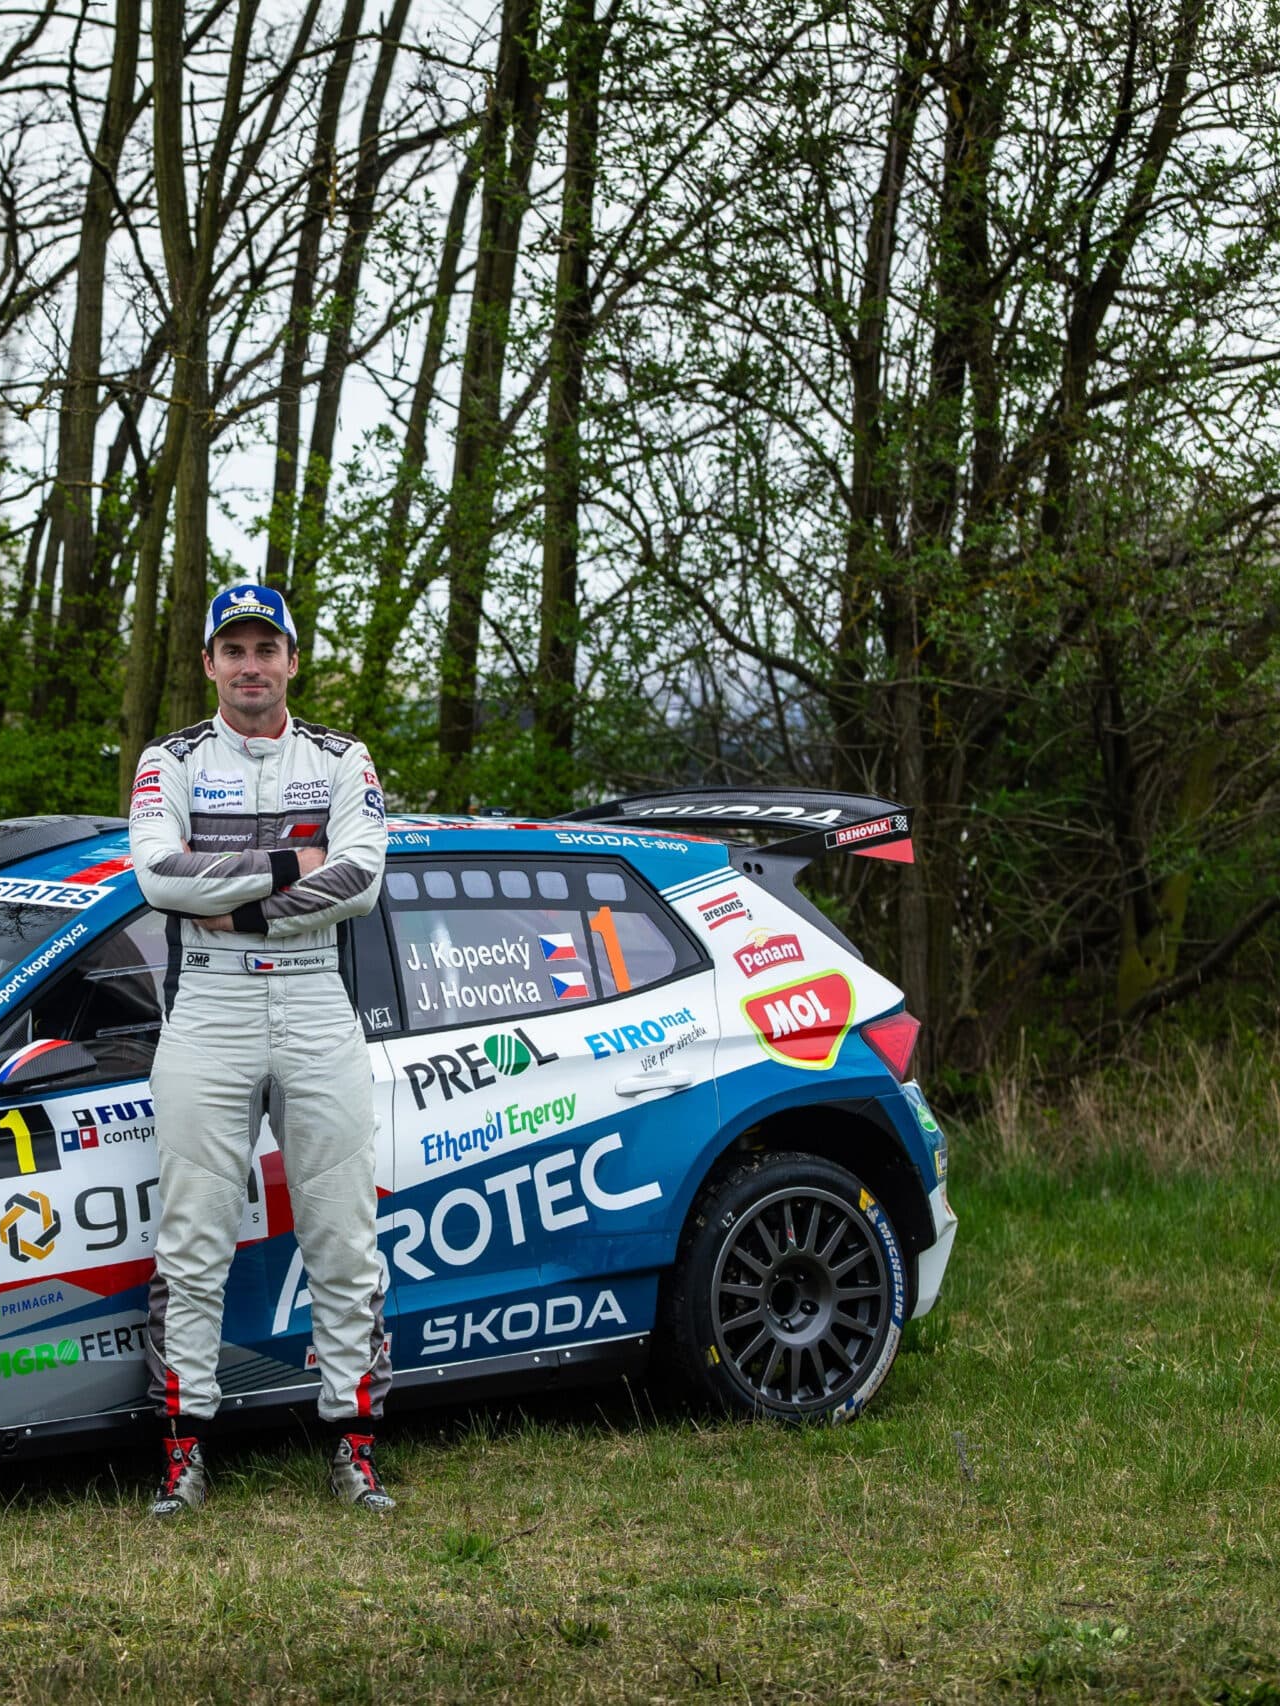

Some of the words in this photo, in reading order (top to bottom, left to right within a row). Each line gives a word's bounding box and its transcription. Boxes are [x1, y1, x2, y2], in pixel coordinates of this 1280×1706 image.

[220, 605, 276, 621] MICHELIN
[194, 787, 227, 799] EVRO
[837, 820, 888, 843] RENOVAK
[638, 837, 689, 854] E-shop
[702, 898, 744, 922] arexons
[186, 955, 210, 964] OMP
[277, 956, 293, 967] Jan
[407, 943, 428, 971] J.
[430, 935, 530, 974] Kopecký
[589, 905, 632, 993] 1
[740, 941, 800, 973] Penam
[418, 982, 439, 1011] J.
[440, 976, 542, 1009] Hovorka
[763, 989, 831, 1039] MOL
[583, 1019, 666, 1061] EVRO
[659, 1007, 697, 1028] mat
[660, 1044, 675, 1066] pro
[95, 1098, 155, 1125] FUT
[505, 1093, 577, 1135] Energy
[877, 1220, 904, 1319] MICHELIN
[1, 1291, 64, 1317] PRIMAGRA
